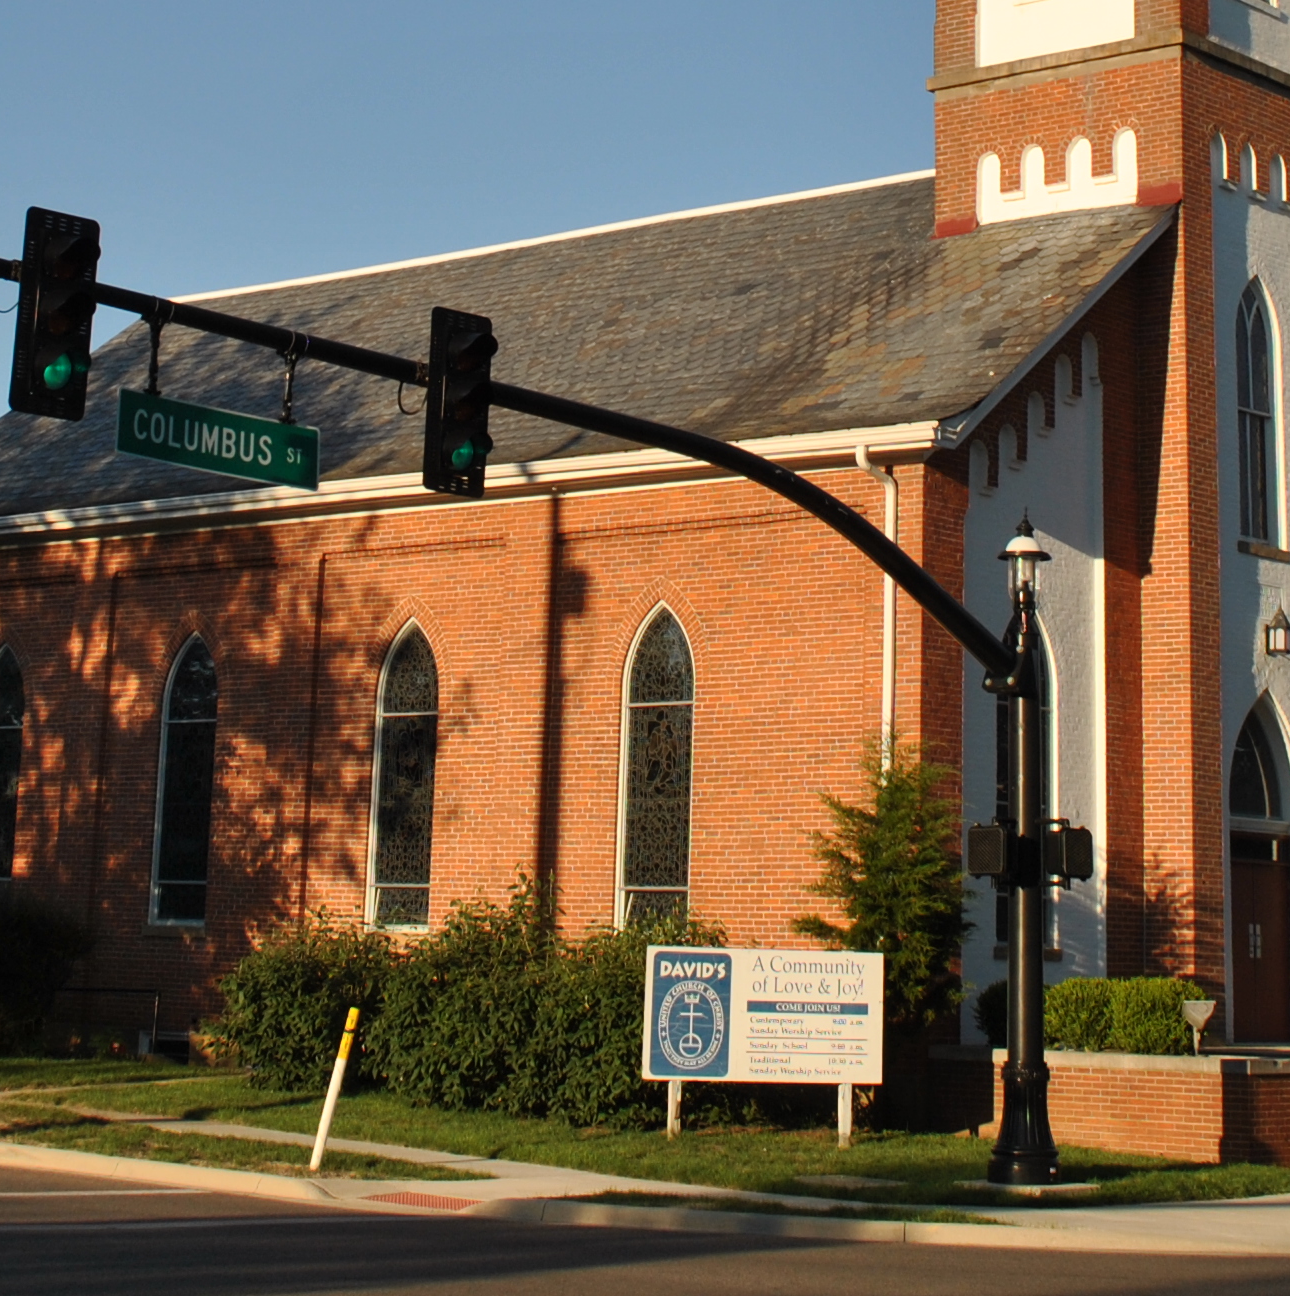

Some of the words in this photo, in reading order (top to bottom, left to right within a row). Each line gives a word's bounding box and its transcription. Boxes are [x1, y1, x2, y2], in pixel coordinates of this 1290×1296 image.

[133, 408, 272, 466] COLUMBUS
[286, 447, 303, 464] ST
[660, 960, 726, 980] DAVID'S
[752, 955, 765, 972] A
[769, 955, 865, 981] Community
[672, 982, 705, 996] CHURCH
[706, 989, 717, 1001] OF
[752, 975, 769, 993] of
[774, 976, 813, 994] Love
[817, 977, 831, 994] &
[836, 978, 864, 1001] Joy!
[775, 1003, 803, 1012] COME
[804, 1004, 824, 1013] JOIN
[826, 1004, 841, 1013] US!
[750, 1026, 778, 1037] Sunday
[781, 1027, 812, 1038] Worship
[750, 1041, 778, 1051] Sunday
